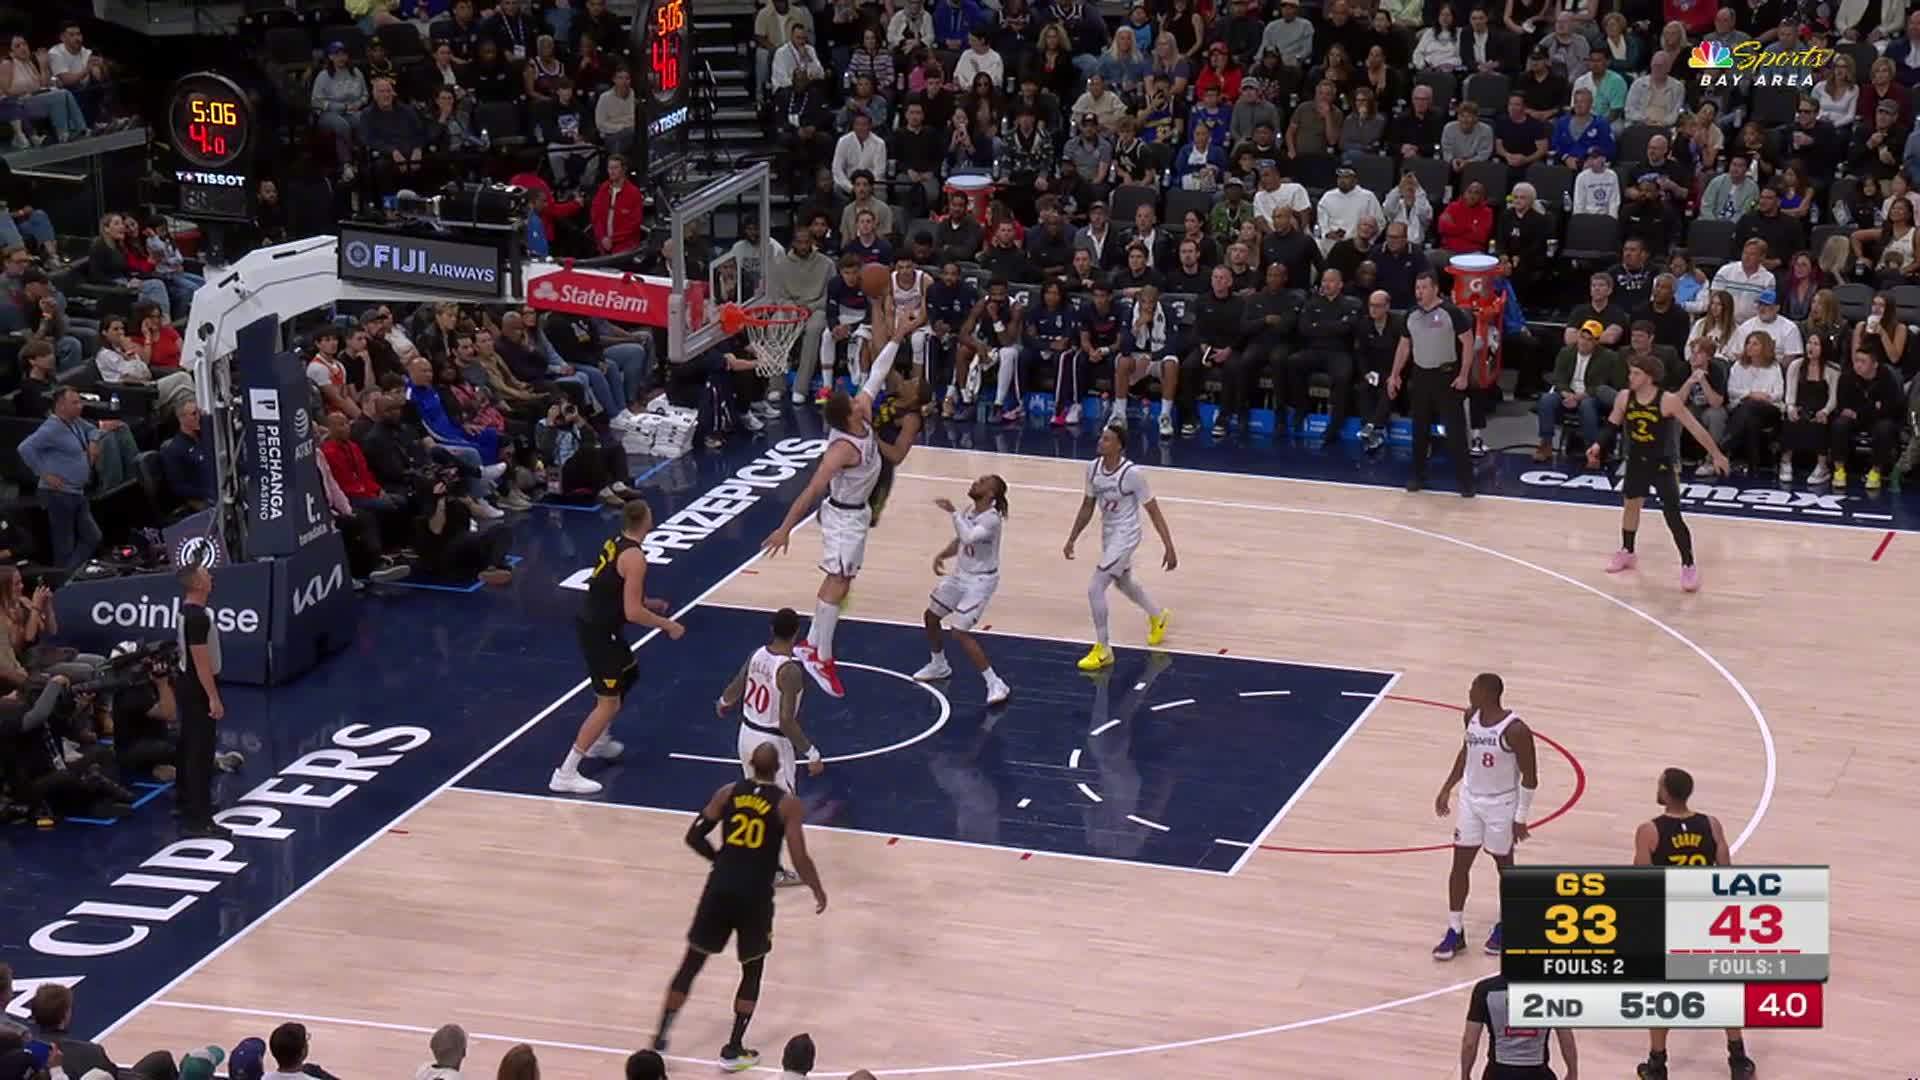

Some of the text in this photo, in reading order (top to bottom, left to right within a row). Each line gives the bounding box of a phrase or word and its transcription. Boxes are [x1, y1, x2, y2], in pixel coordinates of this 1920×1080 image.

[191, 100, 237, 126] 5:06
[188, 122, 225, 155] 4.0
[195, 172, 246, 187] TISSOT
[374, 244, 495, 283] FIJI AIRWAYS
[257, 424, 270, 521] RESORT CASINO
[267, 425, 283, 520] PECHANGA
[91, 595, 259, 633] coinse
[744, 677, 770, 714] 20
[1482, 752, 1495, 769] 8
[28, 723, 432, 957] CLIPPERS
[726, 813, 766, 849] 20
